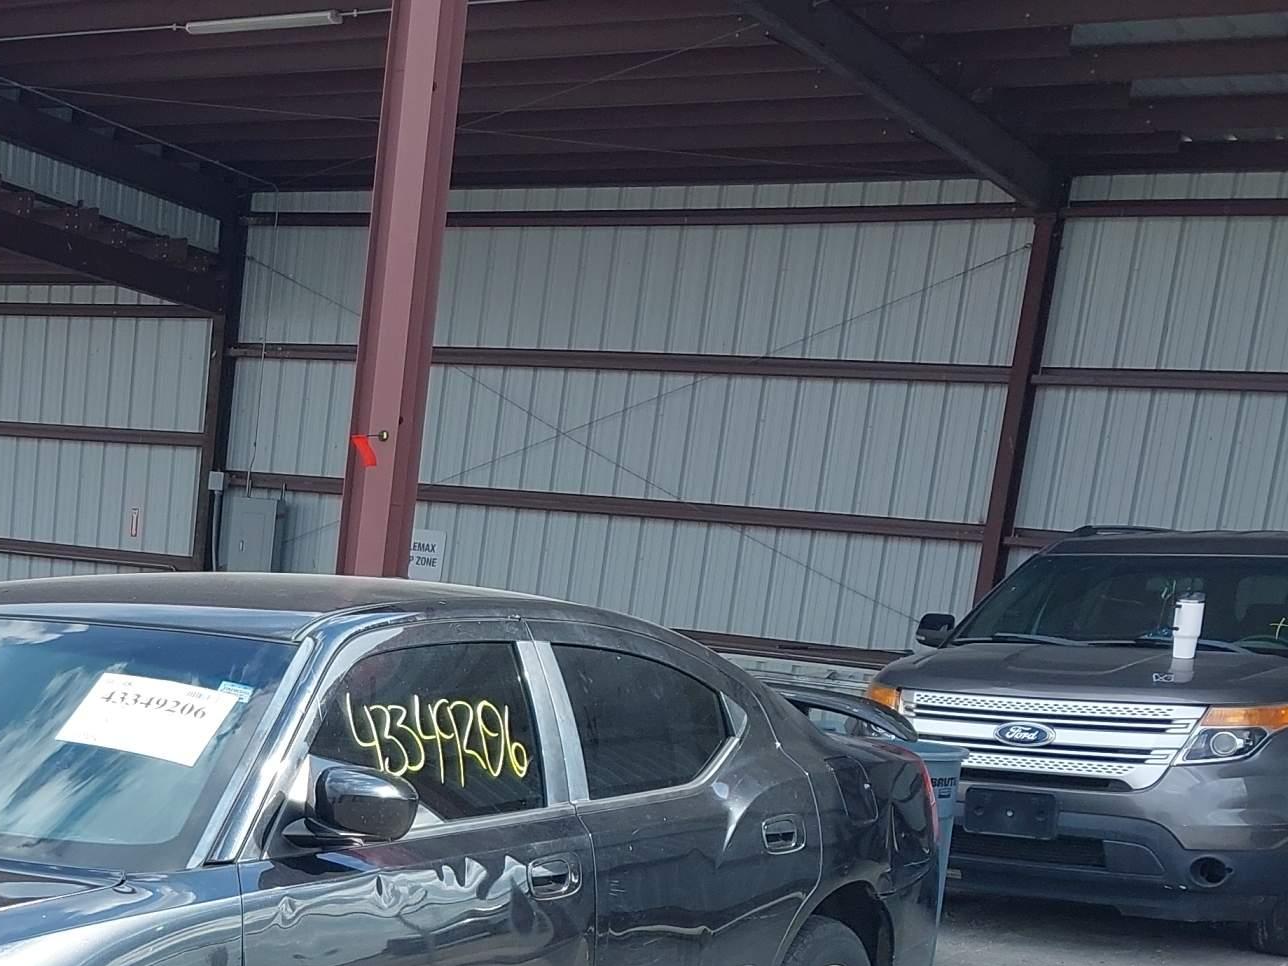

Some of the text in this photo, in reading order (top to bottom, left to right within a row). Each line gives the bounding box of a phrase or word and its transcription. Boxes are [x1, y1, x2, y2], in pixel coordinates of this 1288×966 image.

[410, 542, 436, 553] EMAX
[416, 556, 437, 567] ZONE
[100, 690, 206, 719] 43349206
[345, 692, 528, 787] 43349206
[1005, 725, 1039, 740] Ford
